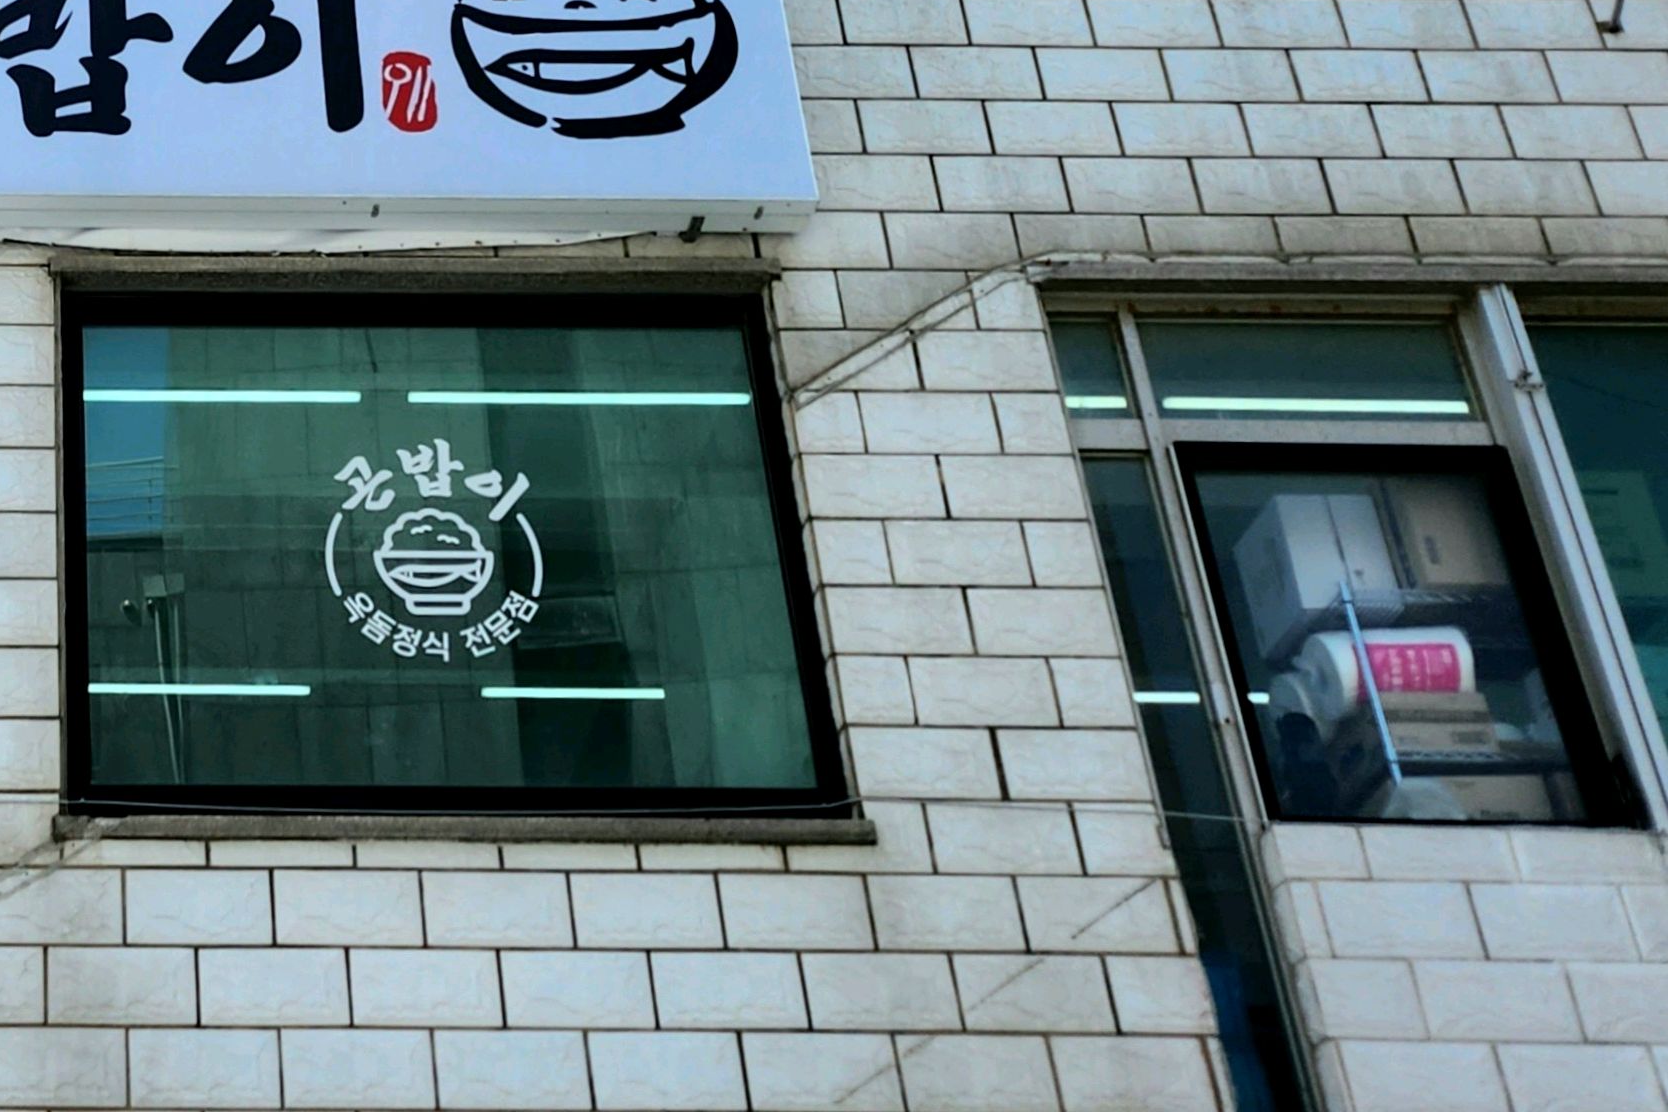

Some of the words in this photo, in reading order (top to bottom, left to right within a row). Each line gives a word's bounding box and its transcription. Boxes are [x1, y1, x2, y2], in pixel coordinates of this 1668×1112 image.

[333, 438, 530, 522] 곤밥이
[342, 591, 450, 663] 옥돔정식
[459, 590, 540, 658] 전문점
